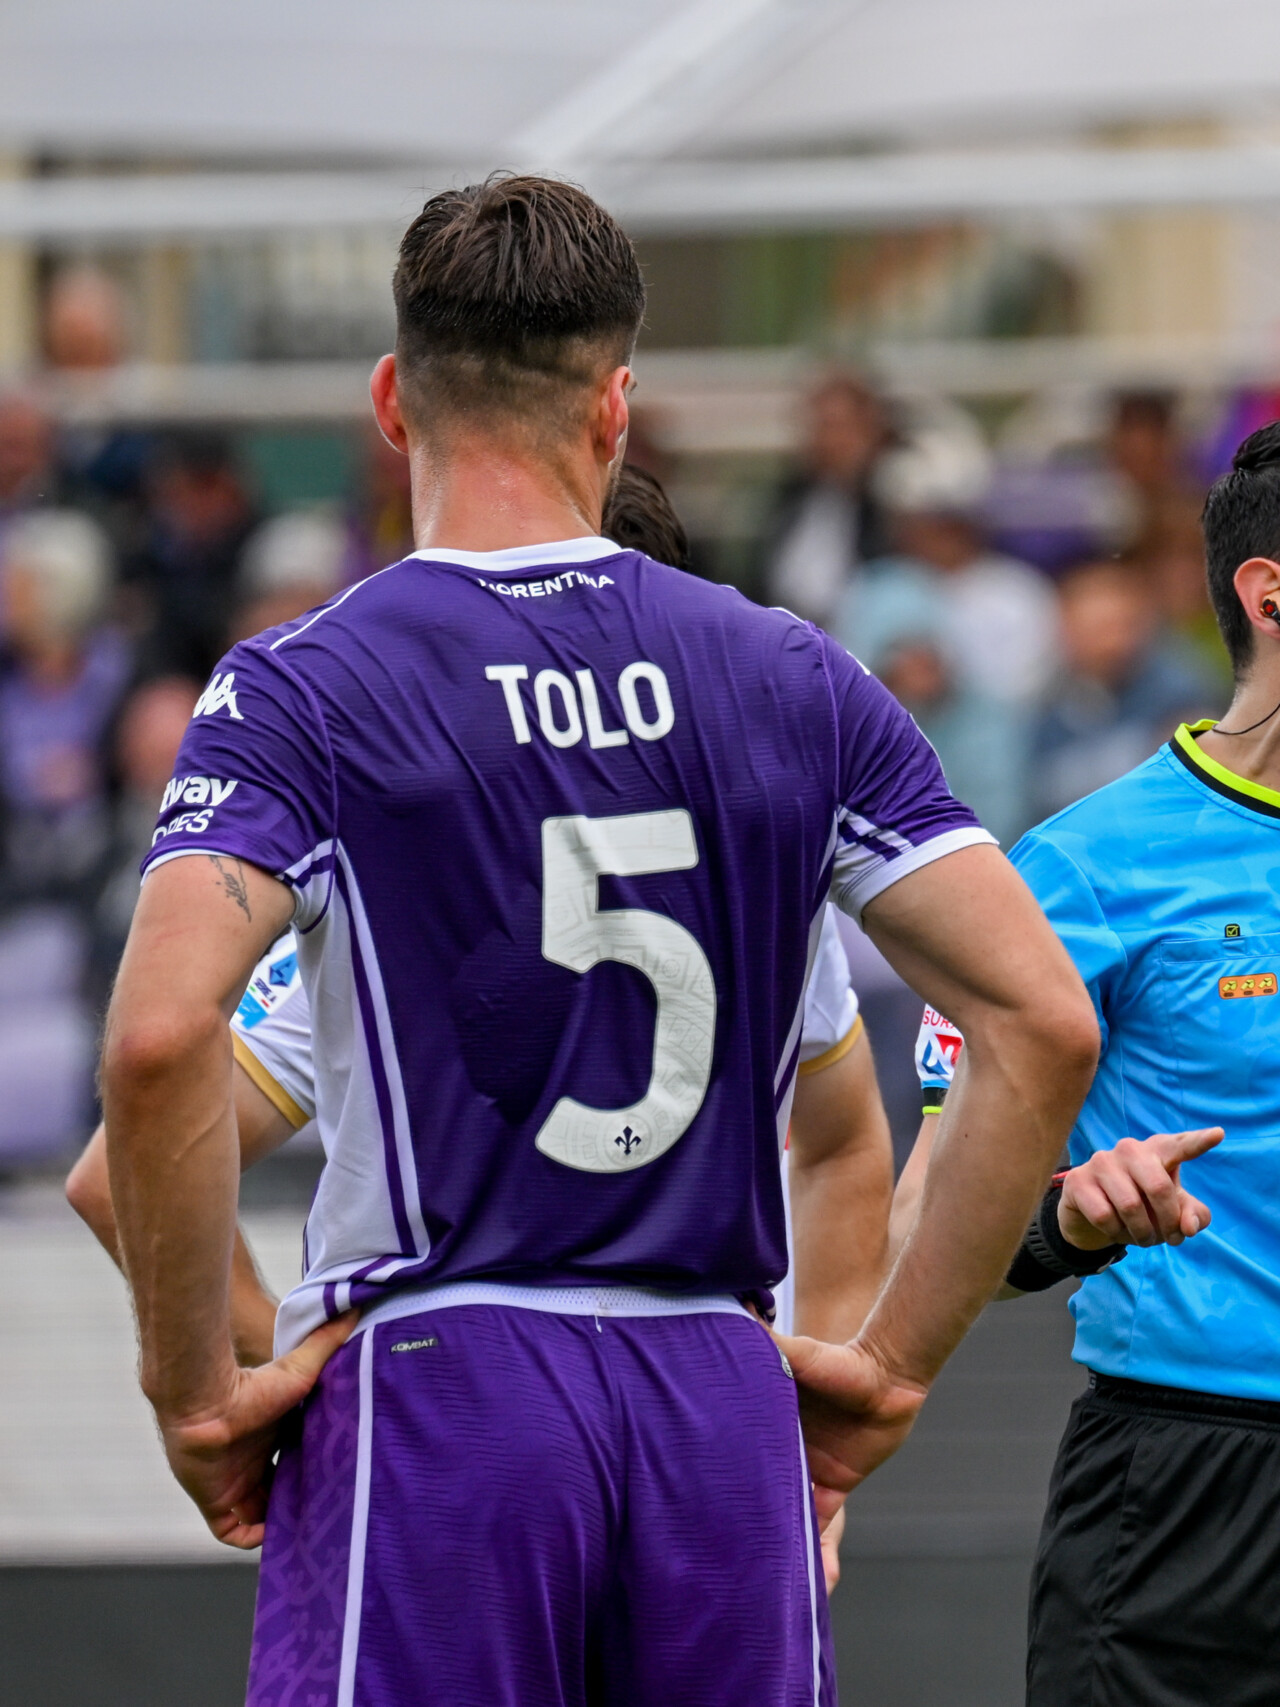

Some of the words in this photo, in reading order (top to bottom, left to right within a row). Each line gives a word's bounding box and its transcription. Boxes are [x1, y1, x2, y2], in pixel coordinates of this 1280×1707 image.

[485, 662, 674, 749] TOLO
[536, 808, 717, 1173] 5
[922, 1010, 955, 1029] SUR
[390, 1338, 435, 1353] KOMBAT
